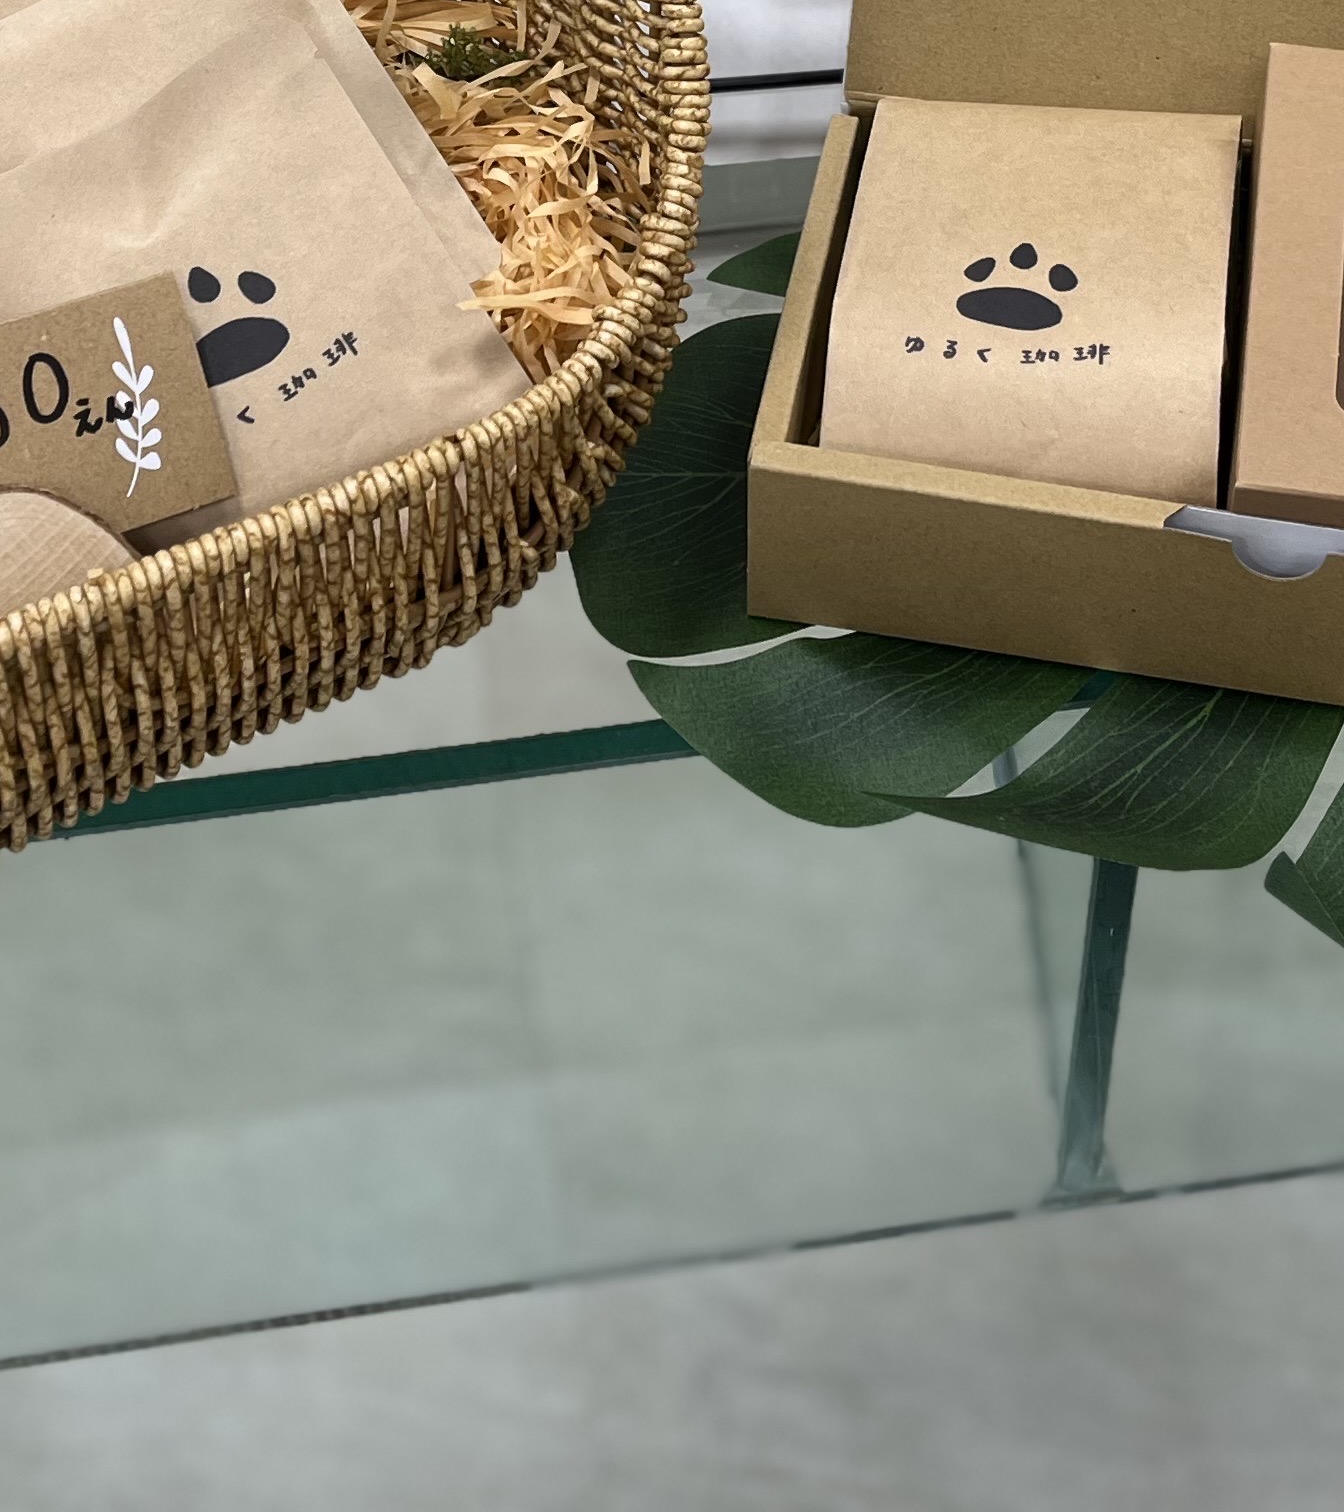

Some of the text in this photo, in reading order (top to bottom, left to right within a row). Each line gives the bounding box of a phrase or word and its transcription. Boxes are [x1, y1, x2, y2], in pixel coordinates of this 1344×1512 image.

[904, 334, 1112, 366] ゆるく珈琲
